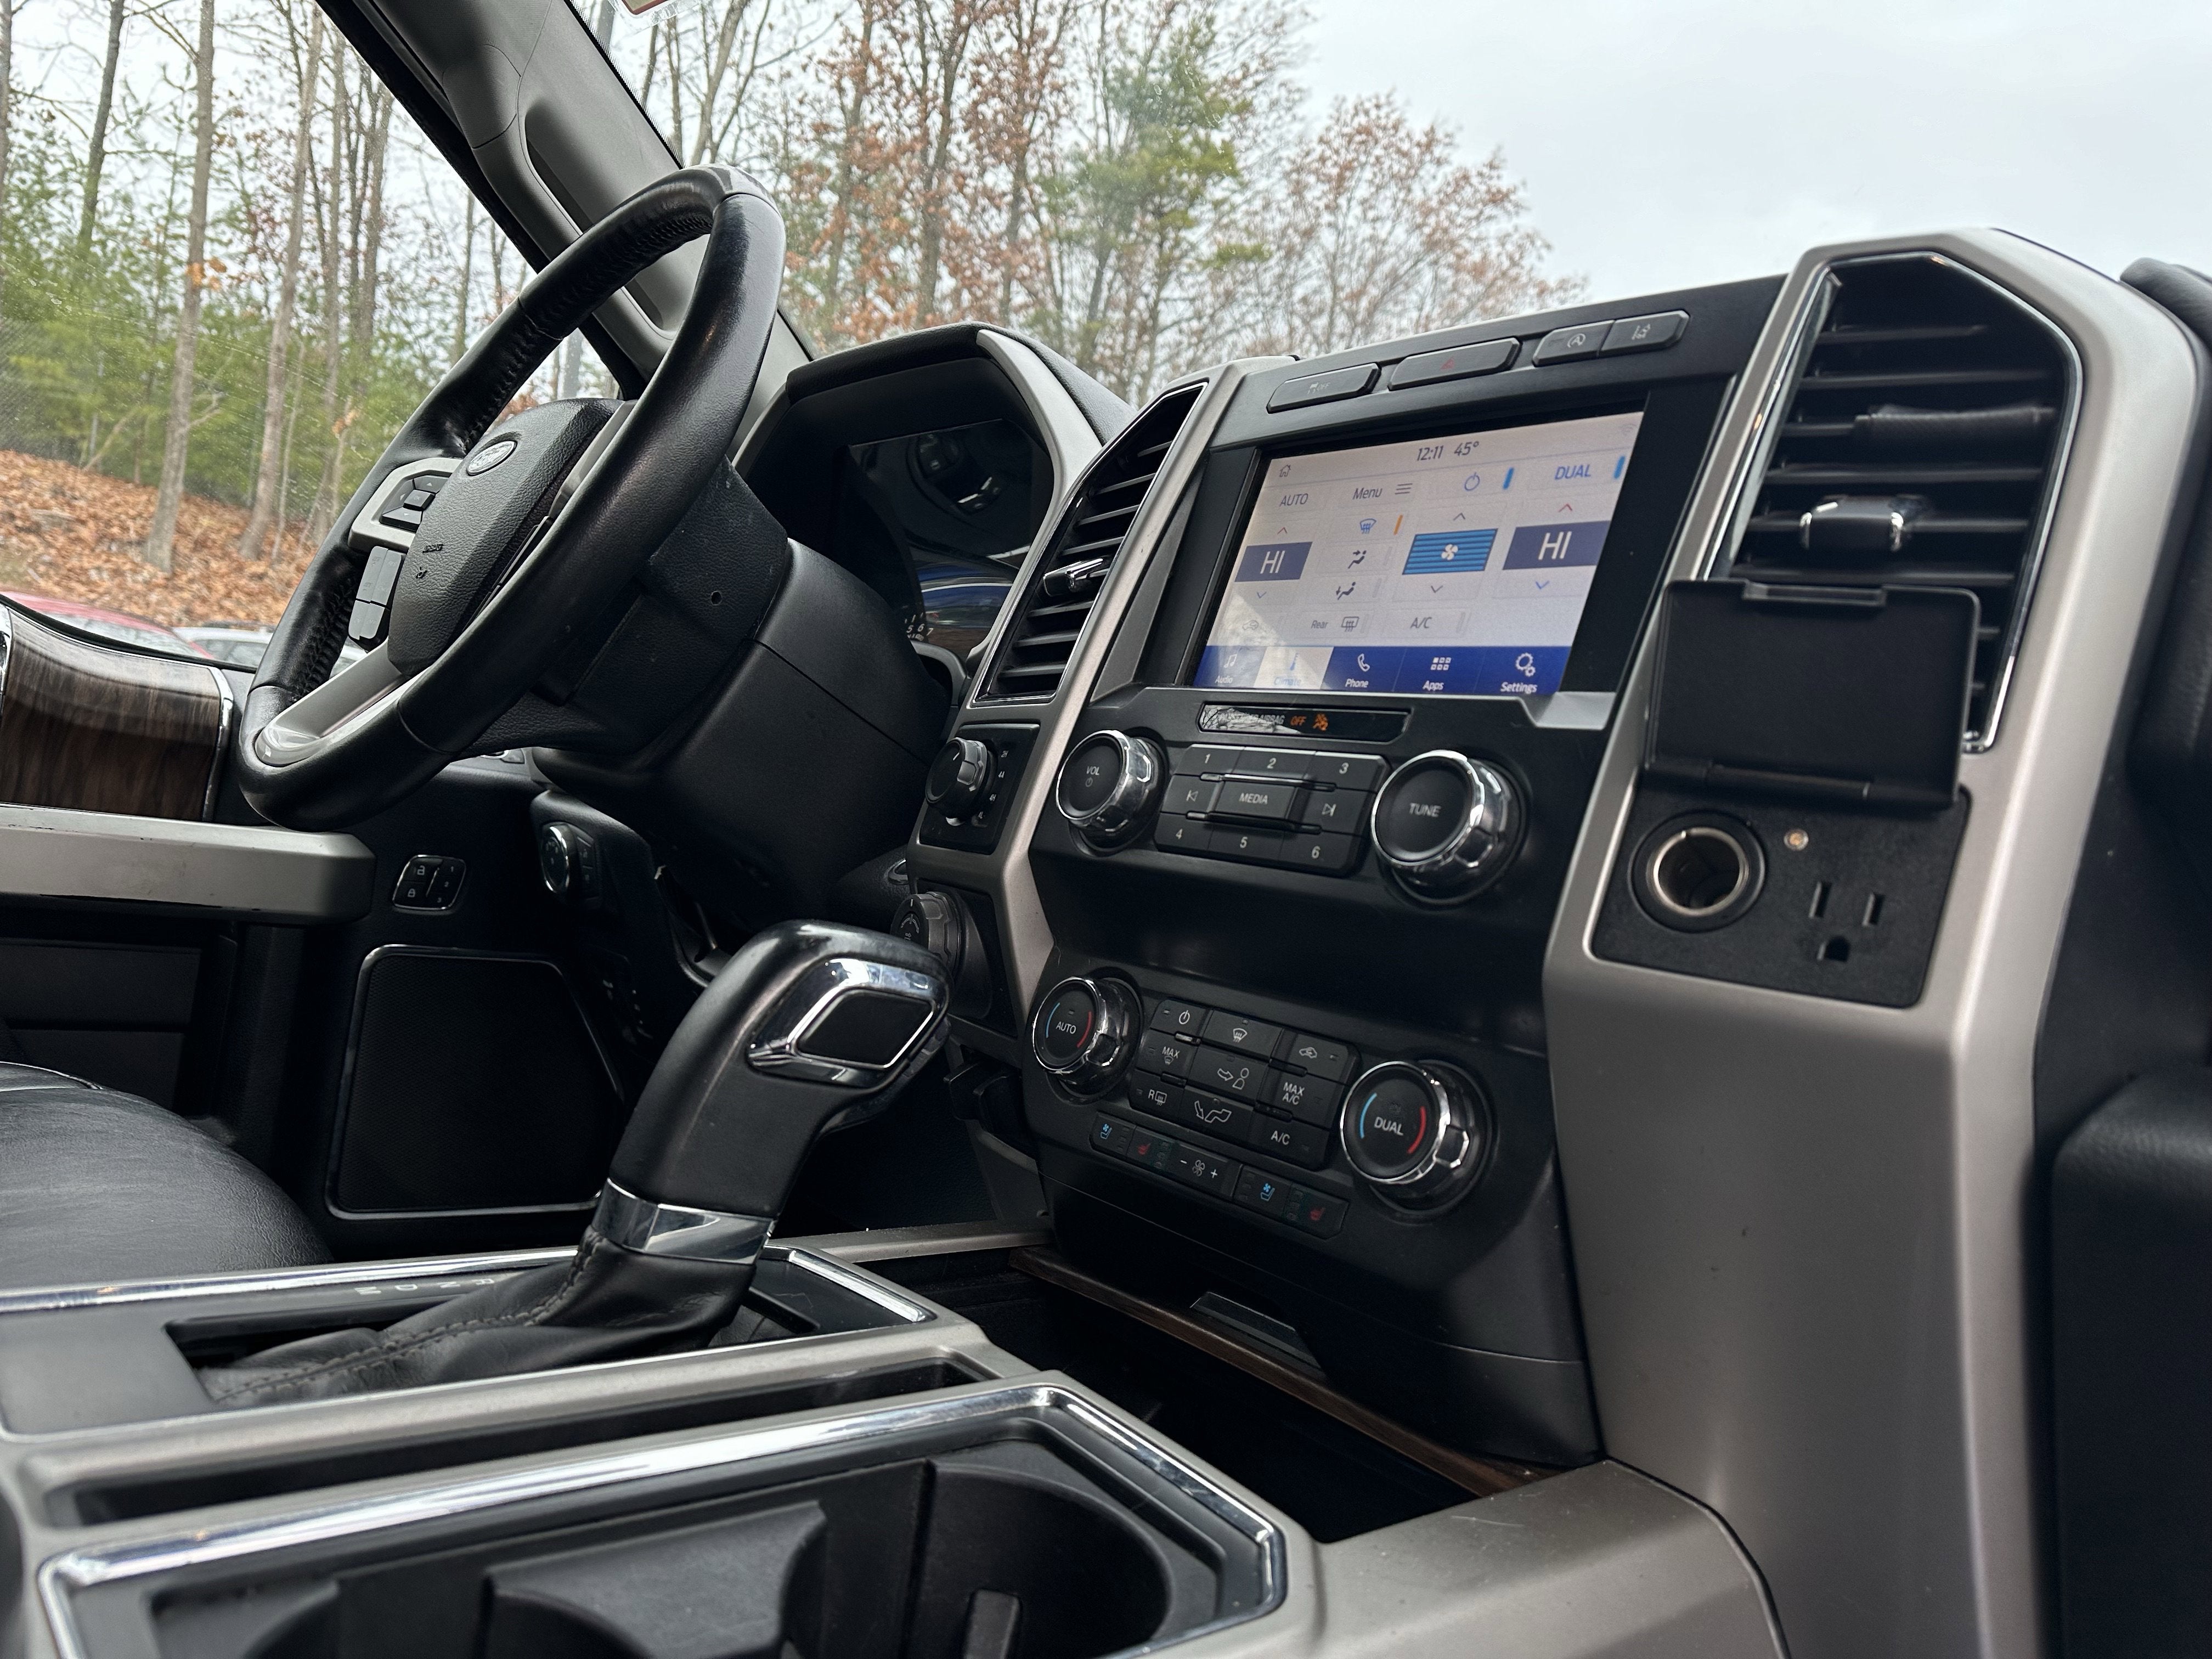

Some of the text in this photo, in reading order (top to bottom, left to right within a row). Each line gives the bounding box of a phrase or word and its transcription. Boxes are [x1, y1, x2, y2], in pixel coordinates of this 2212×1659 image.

[1416, 441, 1480, 461] 12:11 45°
[1554, 464, 1591, 480] DUAL
[1279, 493, 1309, 507] AUTO
[1352, 487, 1383, 500] Menu
[1538, 531, 1572, 560] HI
[1260, 550, 1286, 574] HI
[906, 623, 934, 636] 5 6 7
[1311, 620, 1329, 629] Rear
[1410, 617, 1432, 629] A/C
[1215, 675, 1233, 684] Audio
[1273, 676, 1302, 687] Climate
[1345, 678, 1369, 688] Phone
[1422, 680, 1444, 692] Apps
[1500, 681, 1538, 695] Settings
[1290, 715, 1307, 726] OFF
[1204, 753, 1211, 764] 1
[1267, 757, 1277, 769] 2
[1086, 765, 1100, 776] VOL
[1339, 762, 1350, 774] 3
[1238, 792, 1268, 804] MEDIA
[1409, 802, 1442, 818] TUNE
[1175, 828, 1183, 839] 4
[1239, 836, 1248, 849] 5
[1311, 845, 1321, 859] 6
[1056, 1021, 1077, 1035] AUTO
[1161, 1046, 1181, 1059] MAX
[1148, 1089, 1155, 1100] R
[1283, 1082, 1305, 1097] MAX
[1282, 1093, 1300, 1105] A/C
[1374, 1116, 1404, 1136] DUAL
[1270, 1130, 1290, 1146] A/C
